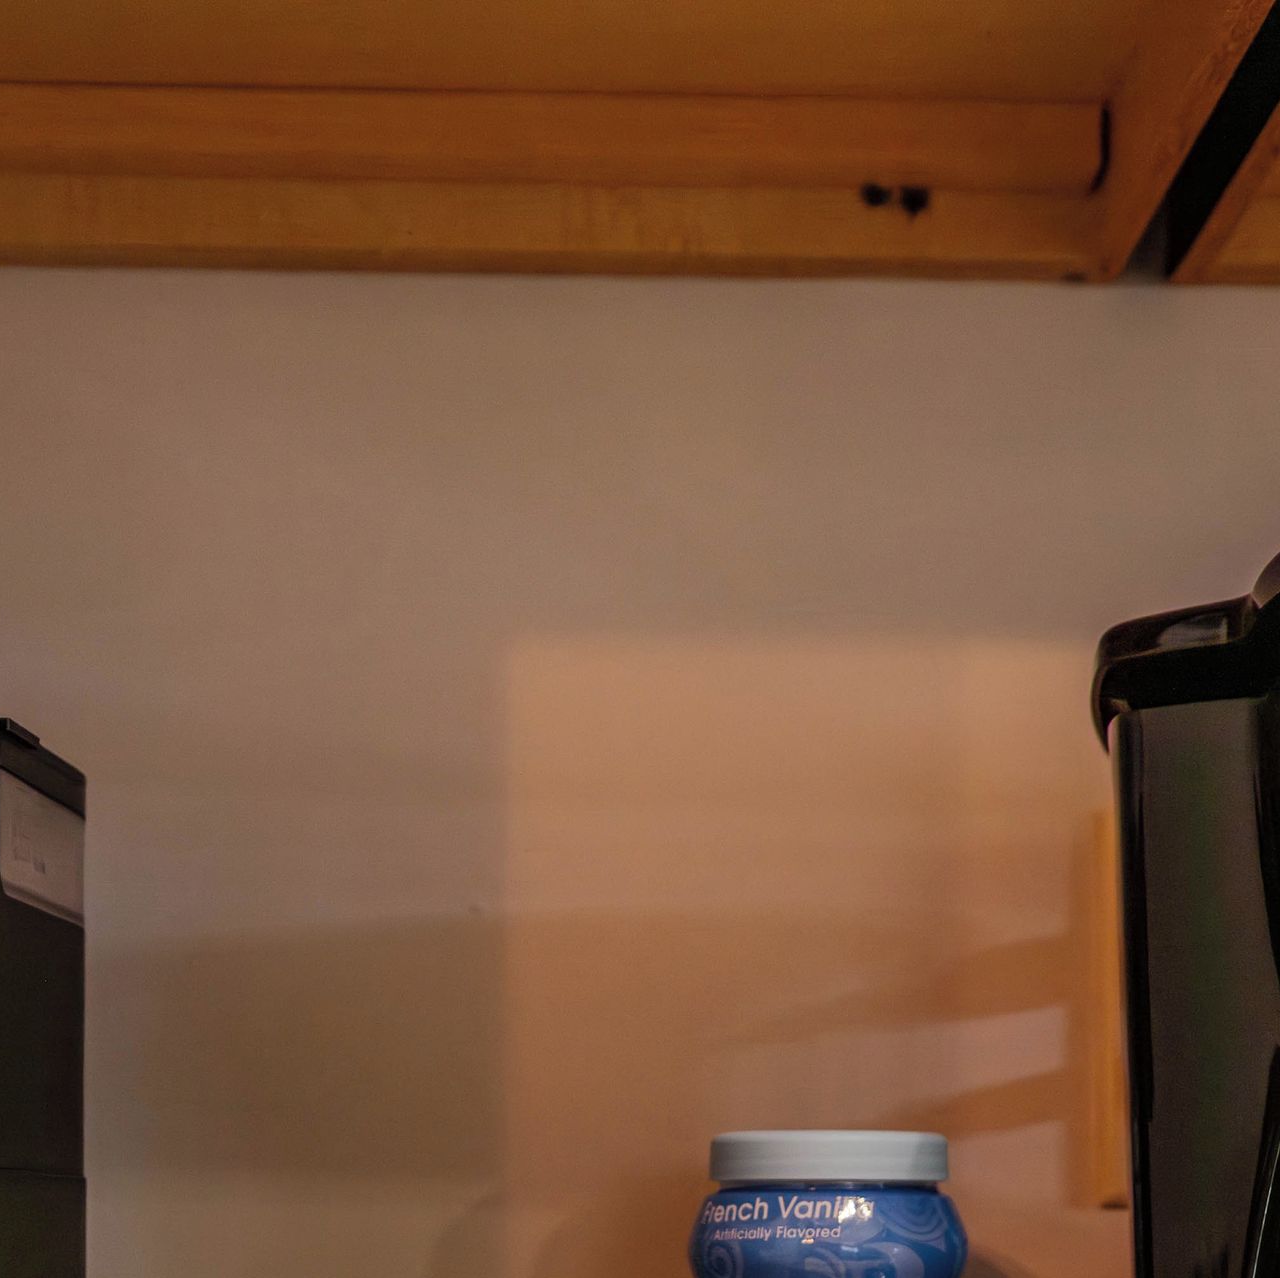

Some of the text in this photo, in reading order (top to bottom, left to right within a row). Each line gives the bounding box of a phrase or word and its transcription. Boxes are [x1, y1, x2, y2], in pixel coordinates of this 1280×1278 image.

[701, 1195, 875, 1225] French Vania
[714, 1225, 842, 1241] Artificially Flavored
